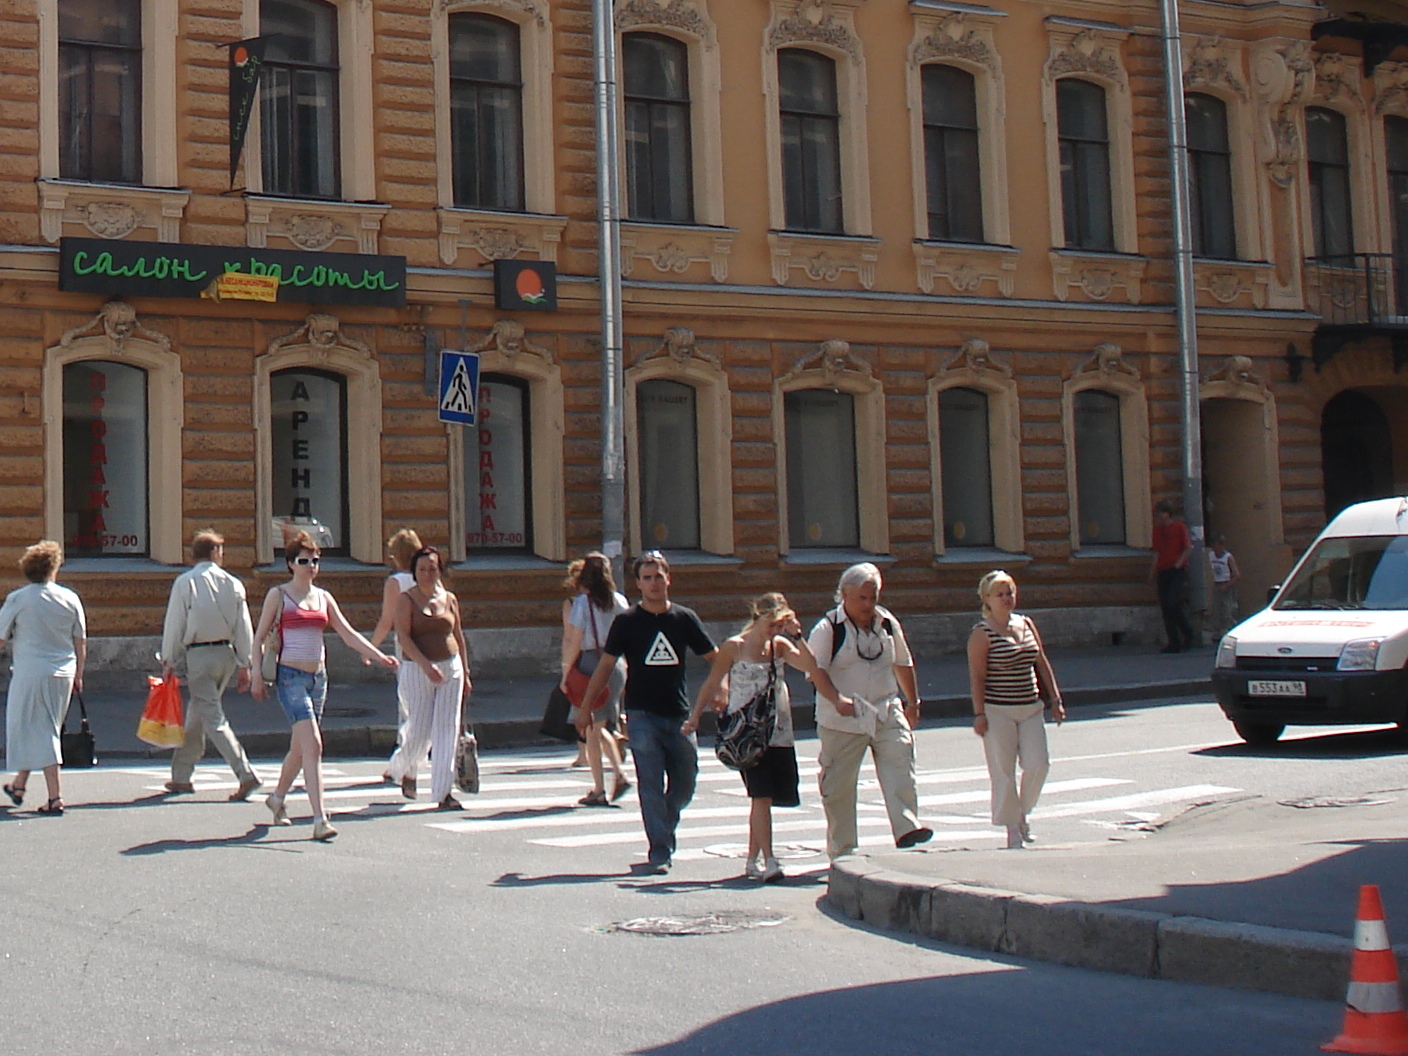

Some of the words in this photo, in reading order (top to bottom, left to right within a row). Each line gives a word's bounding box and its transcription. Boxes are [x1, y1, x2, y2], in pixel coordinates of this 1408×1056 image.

[73, 251, 207, 281] салон
[291, 381, 311, 522] АРЕНД
[478, 386, 497, 532] ПРОДАЖА
